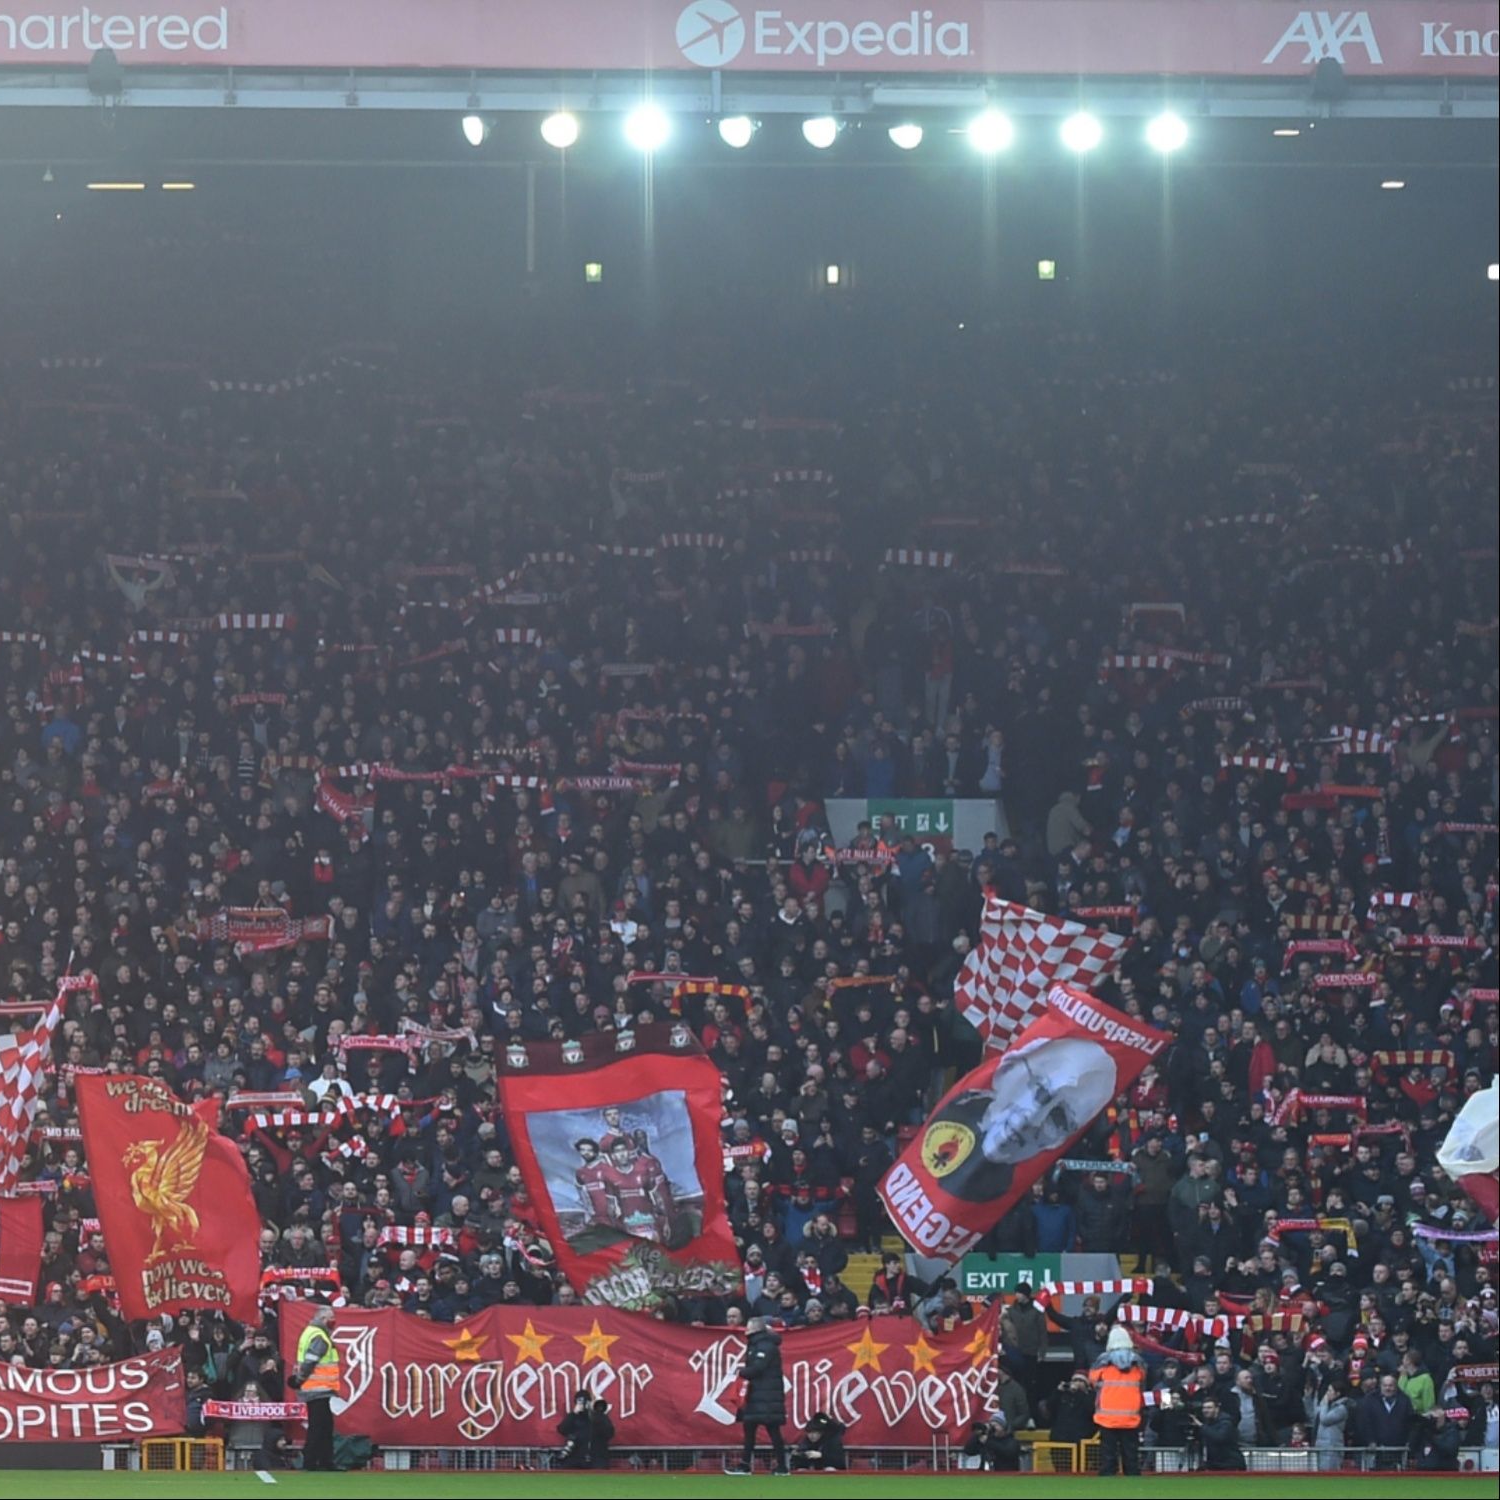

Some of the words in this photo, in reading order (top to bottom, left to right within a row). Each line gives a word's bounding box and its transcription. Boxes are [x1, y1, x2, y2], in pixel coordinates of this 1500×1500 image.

[754, 10, 969, 67] Expedia
[1261, 11, 1384, 65] AXA
[106, 1080, 137, 1097] we
[124, 1092, 193, 1116] dream
[141, 1261, 177, 1285] now
[966, 1272, 1009, 1288] EXIT
[688, 1334, 999, 1429] Blievers
[231, 1403, 287, 1416] LIVERPOOL
